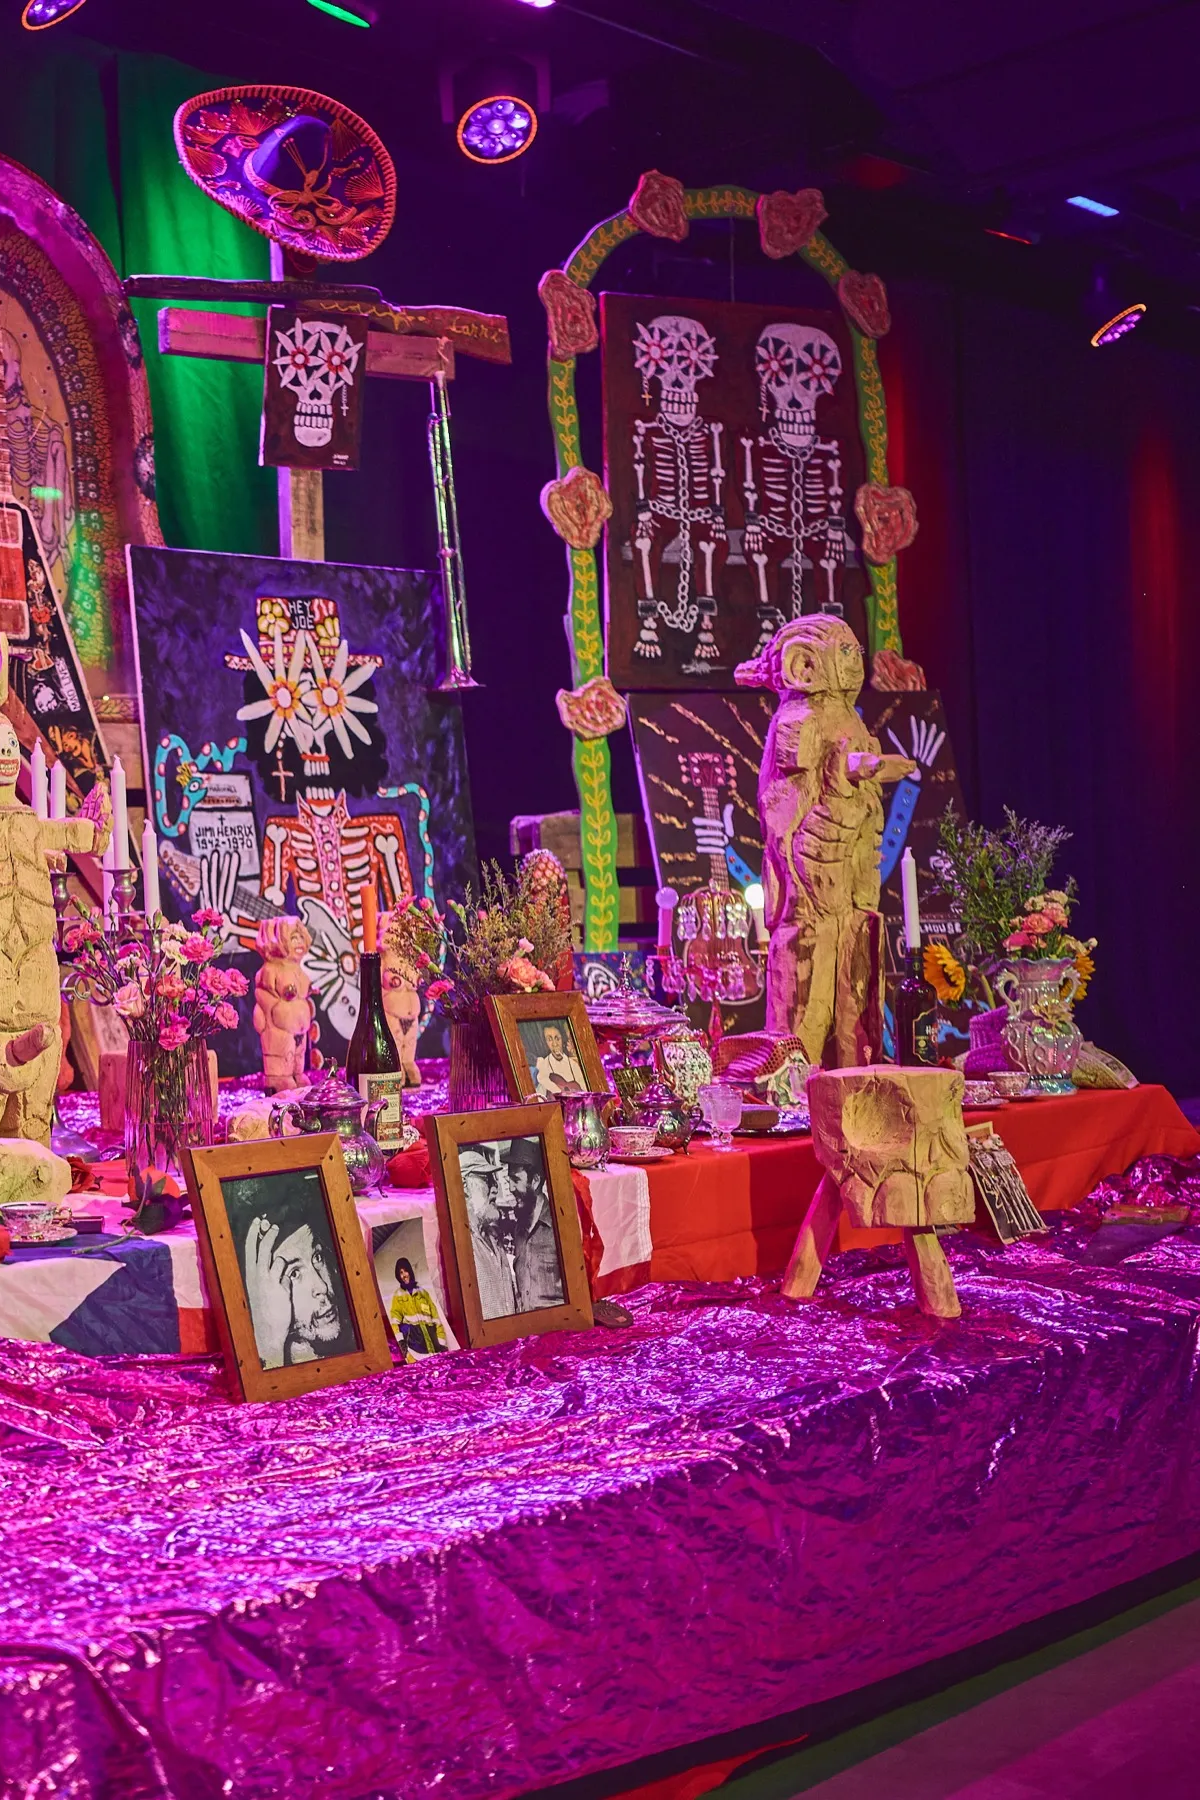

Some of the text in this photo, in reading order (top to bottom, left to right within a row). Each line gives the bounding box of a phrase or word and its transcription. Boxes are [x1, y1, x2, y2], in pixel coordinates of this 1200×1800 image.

[288, 600, 314, 618] HEY
[291, 615, 314, 629] JOE
[195, 824, 254, 839] JIMI HENRIX
[196, 837, 253, 850] 1942-1970
